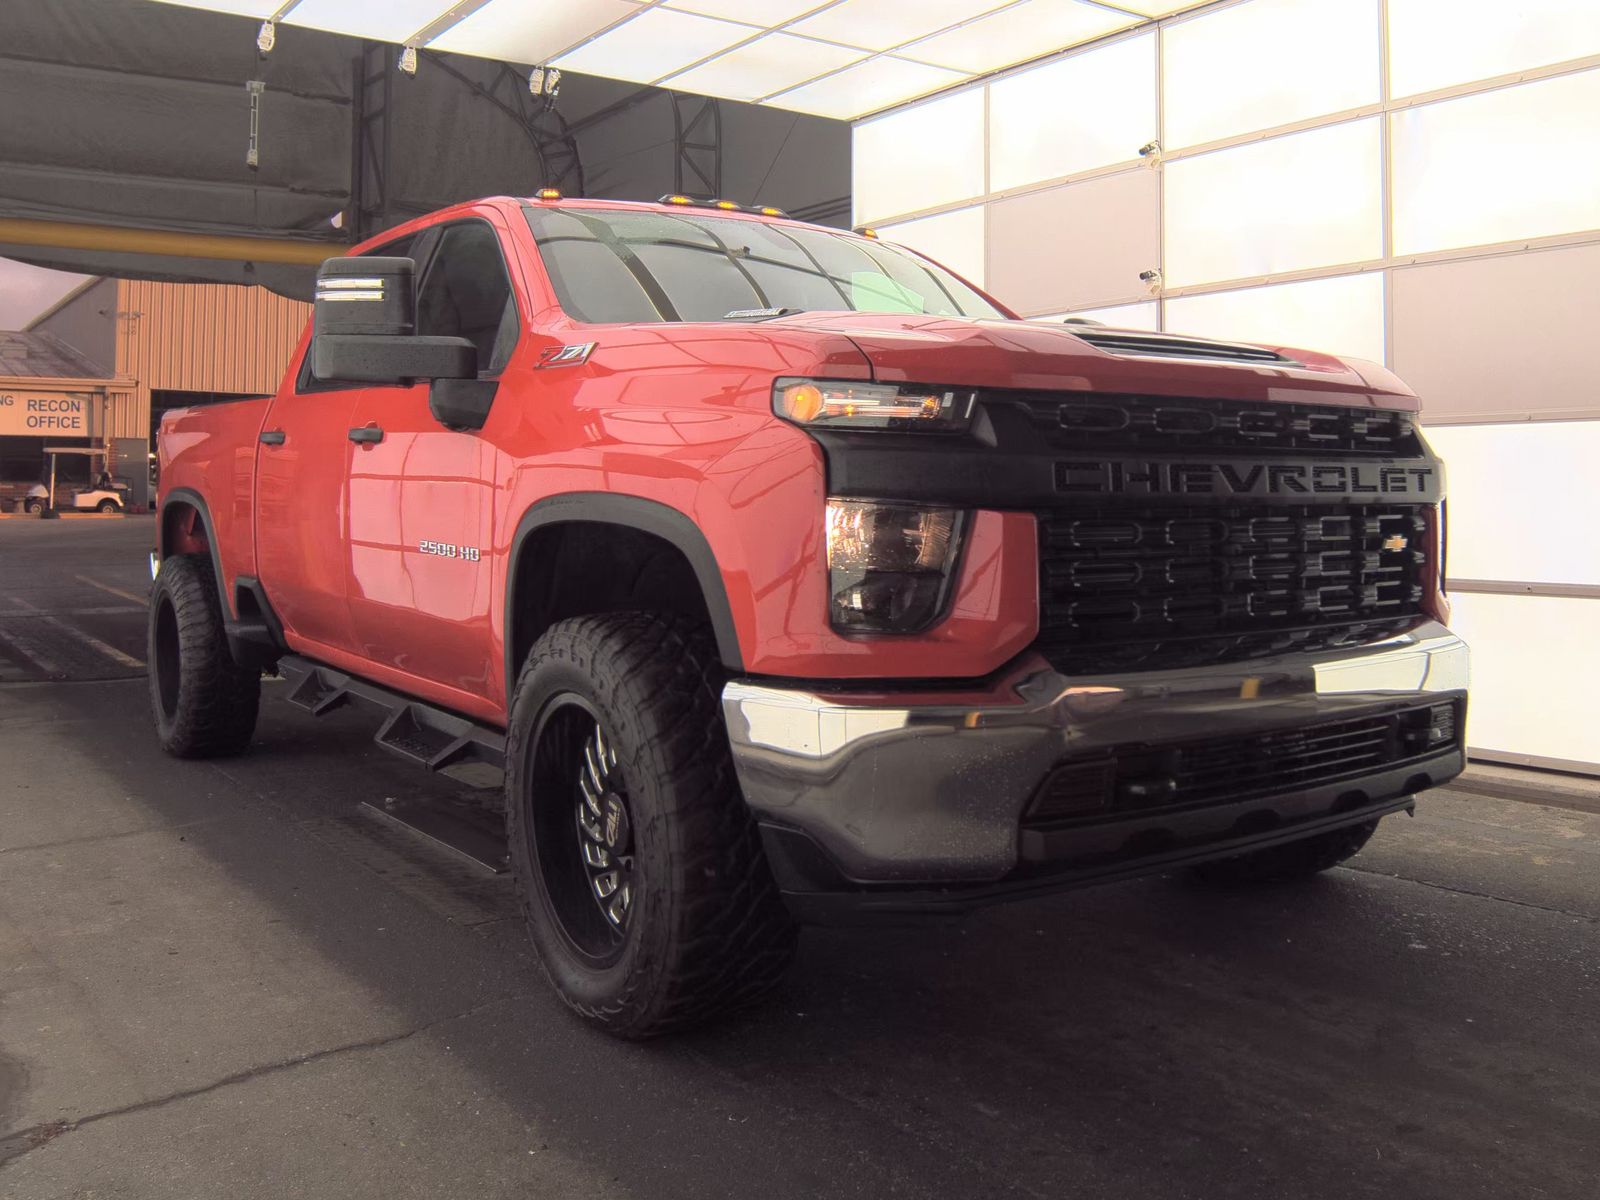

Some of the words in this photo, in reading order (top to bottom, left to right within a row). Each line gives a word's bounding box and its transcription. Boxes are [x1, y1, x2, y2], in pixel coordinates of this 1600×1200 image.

[533, 342, 599, 370] Z71
[27, 399, 80, 412] RECON
[26, 415, 80, 429] OFFICE
[1052, 462, 1433, 493] CHEVROLET
[419, 539, 457, 558] 2500
[460, 546, 480, 562] HD
